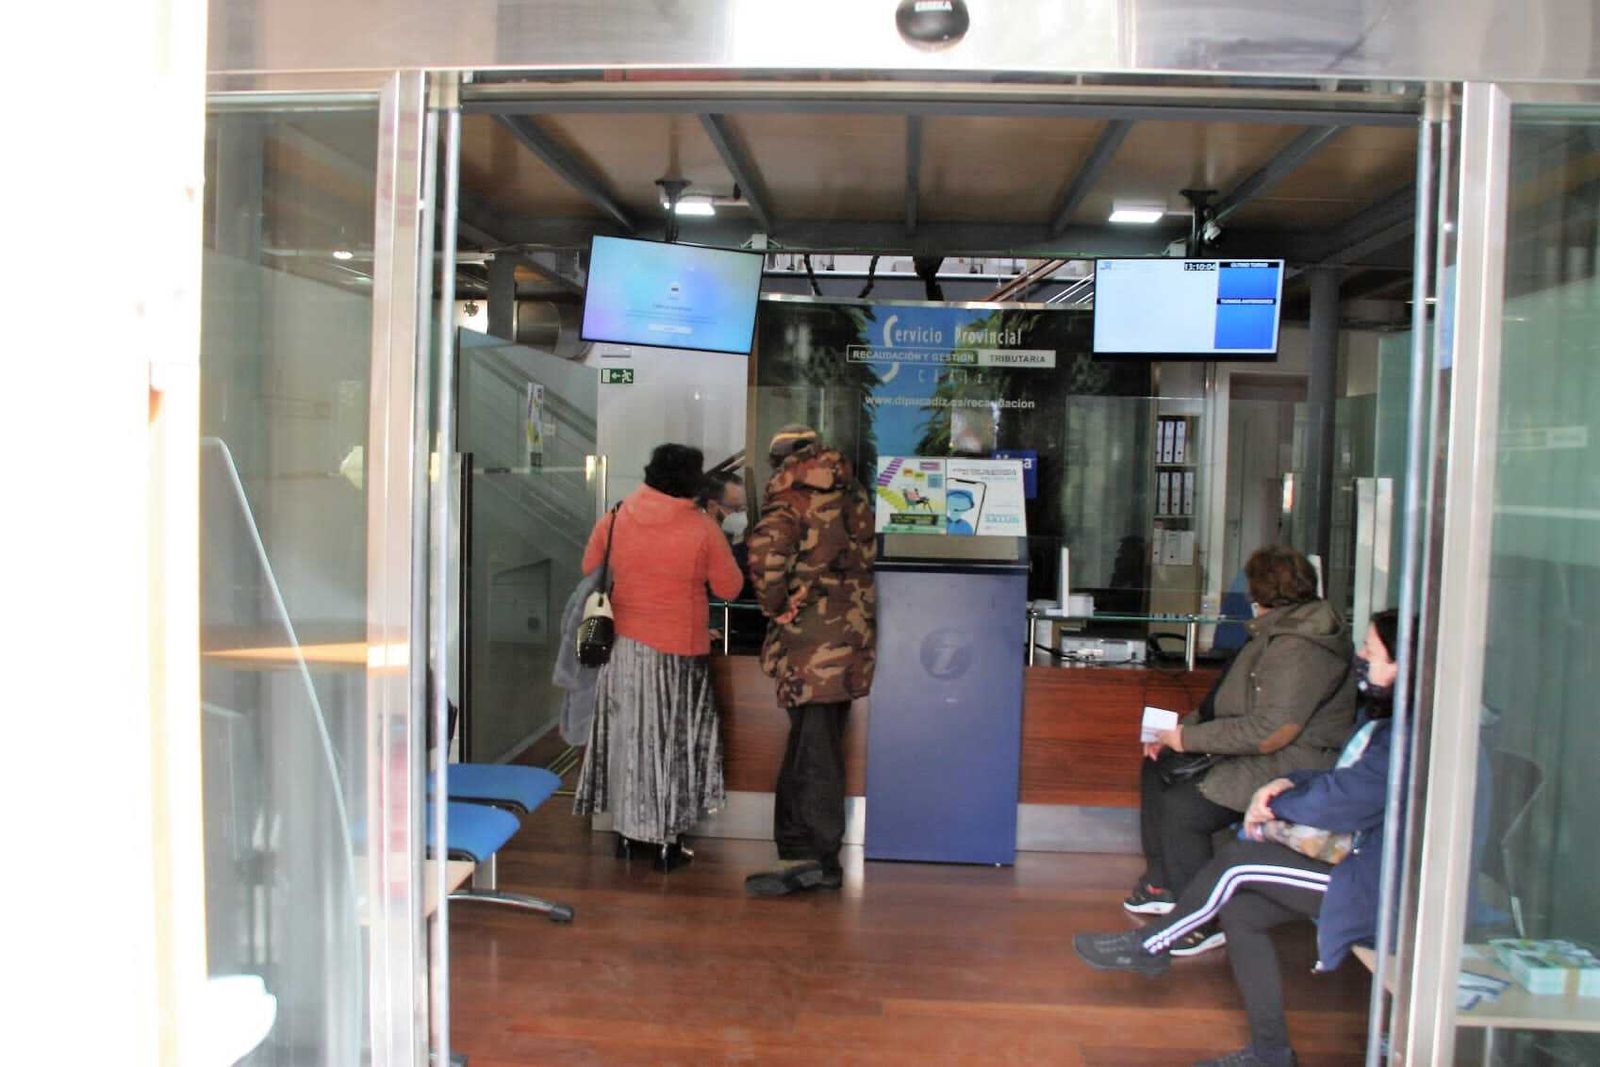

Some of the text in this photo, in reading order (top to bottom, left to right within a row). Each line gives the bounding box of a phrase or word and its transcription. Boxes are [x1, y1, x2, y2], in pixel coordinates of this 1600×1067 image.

[955, 325, 1022, 345] Provincial
[990, 354, 1046, 363] TRIBUTARIA
[865, 394, 1035, 409] www.dipucadiz.es/recadacion
